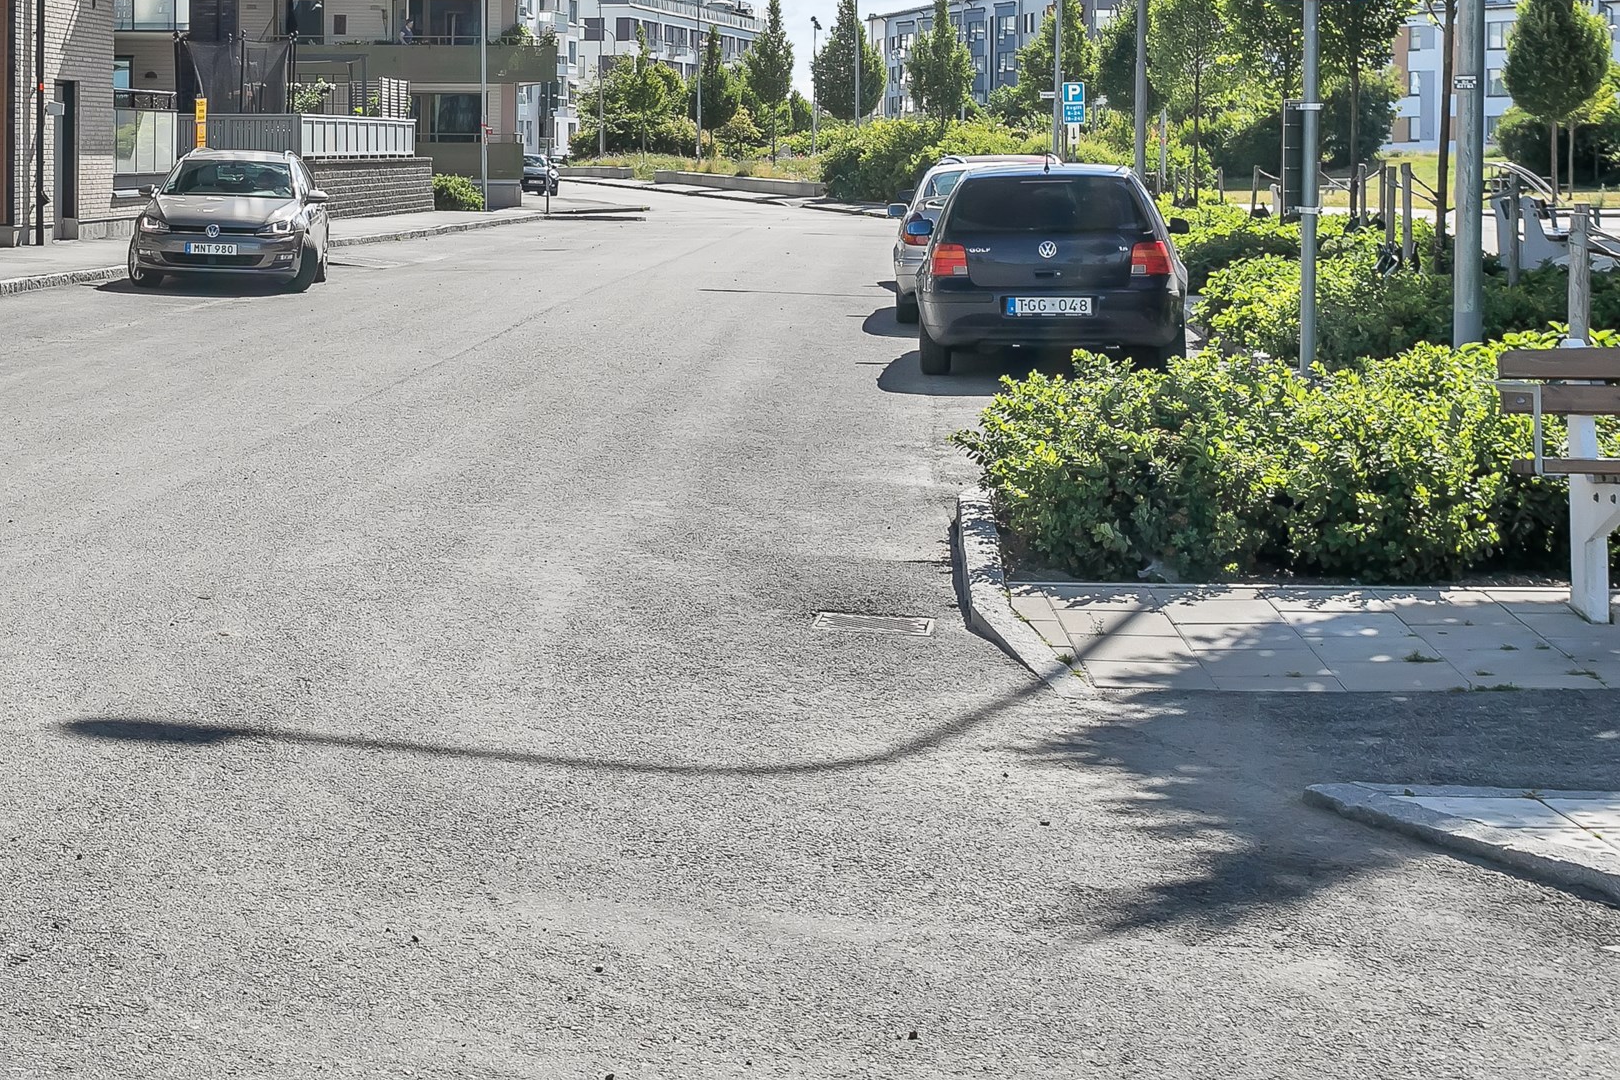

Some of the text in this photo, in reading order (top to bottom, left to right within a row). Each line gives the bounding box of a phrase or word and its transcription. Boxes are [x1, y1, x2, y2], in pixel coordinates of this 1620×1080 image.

[1068, 85, 1081, 101] P
[194, 244, 233, 254] MNT 980
[1017, 299, 1089, 312] TGG 048
